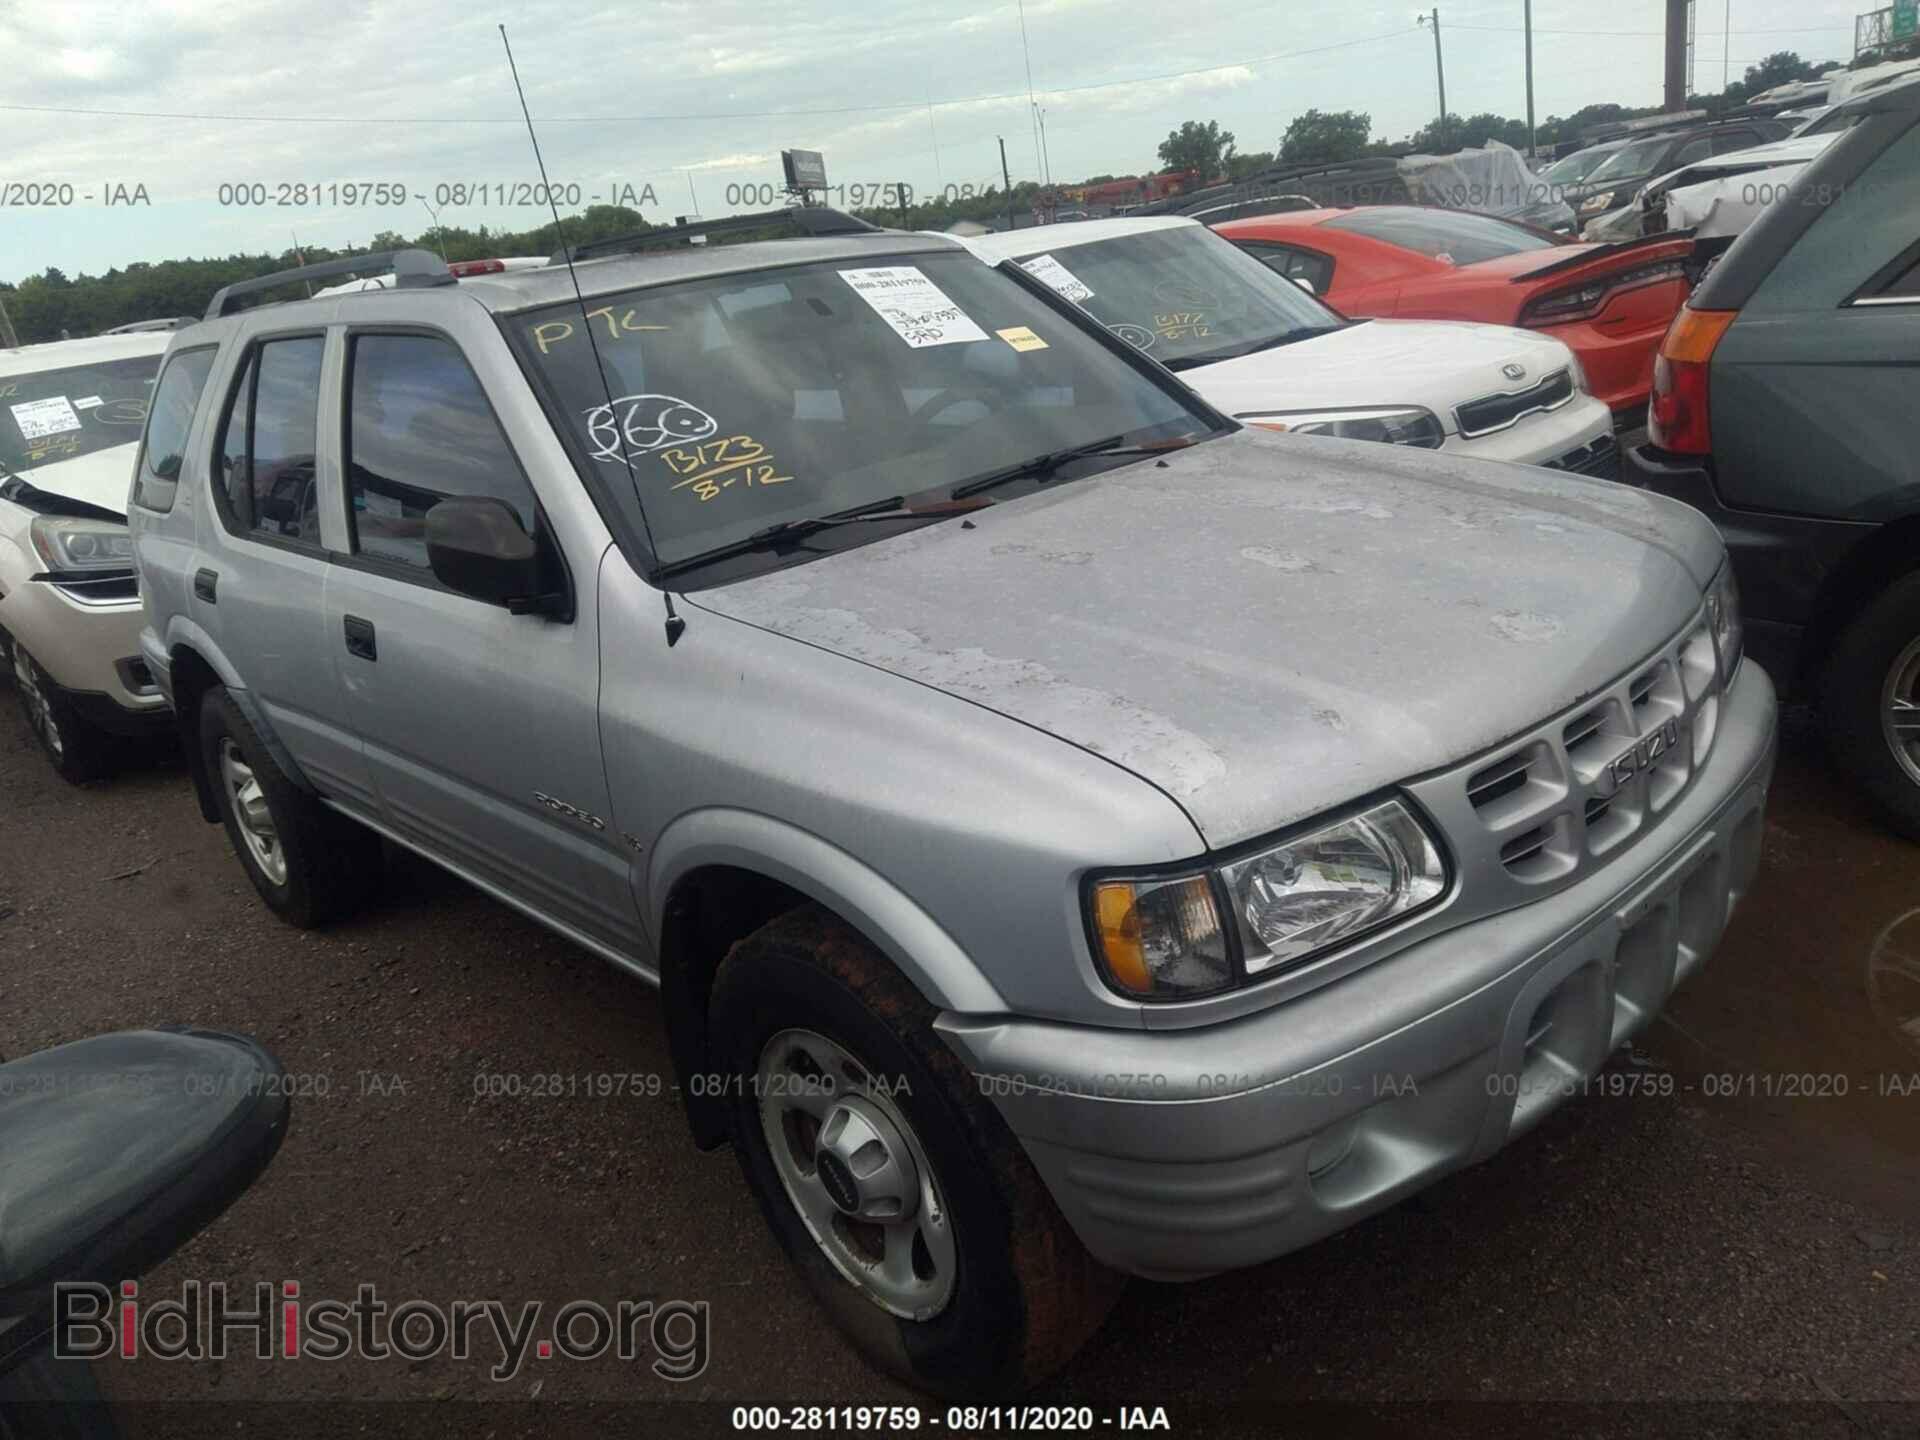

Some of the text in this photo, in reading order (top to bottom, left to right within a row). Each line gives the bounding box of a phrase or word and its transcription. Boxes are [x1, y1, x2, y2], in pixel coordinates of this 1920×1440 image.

[661, 436, 764, 473] B173
[693, 465, 795, 500] 8-12
[1607, 714, 1679, 789] ISUZU
